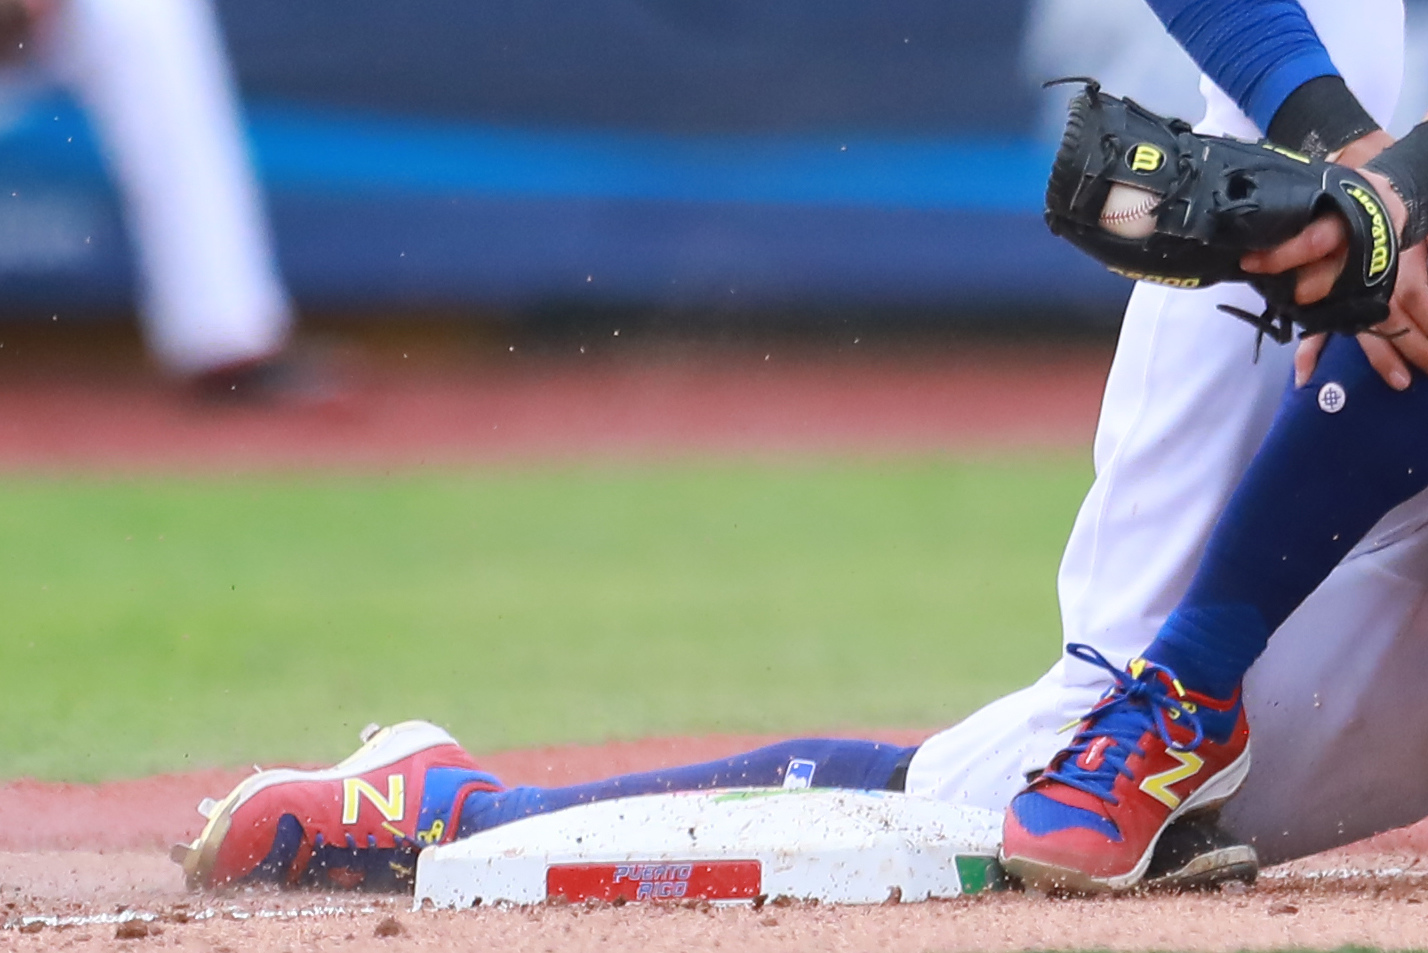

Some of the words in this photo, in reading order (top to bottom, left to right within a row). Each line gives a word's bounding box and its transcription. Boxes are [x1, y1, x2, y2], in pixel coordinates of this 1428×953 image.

[342, 774, 405, 824] N
[612, 864, 694, 884] PUERTO
[636, 881, 688, 901] RICO
